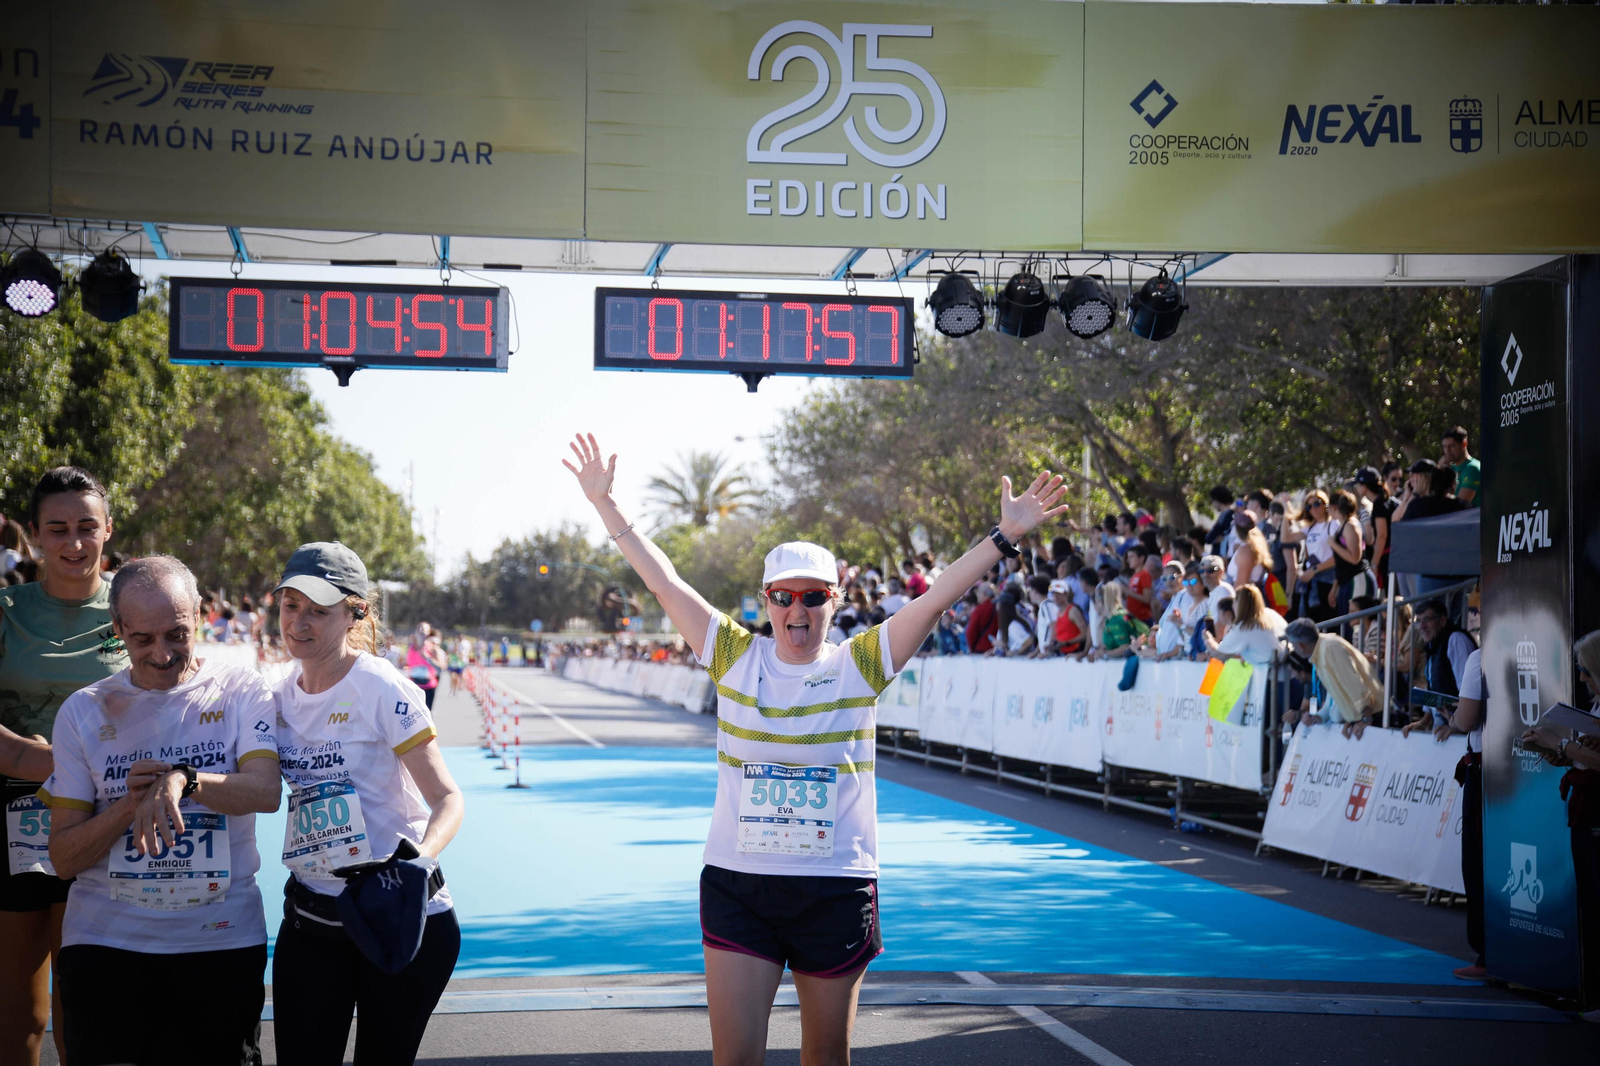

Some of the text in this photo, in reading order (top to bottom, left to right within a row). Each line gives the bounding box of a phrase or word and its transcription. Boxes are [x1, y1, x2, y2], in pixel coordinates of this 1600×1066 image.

[189, 61, 275, 82] RFEA
[180, 81, 266, 98] SERIES
[746, 19, 948, 168] 25
[173, 97, 315, 115] RUTA RUNNING
[79, 119, 494, 165] RAMÓN RUIZ ANDÚJAR
[1129, 133, 1249, 151] COOPERACIÓN
[1514, 131, 1588, 148] CIUDAD
[1129, 151, 1169, 165] 2005
[1227, 152, 1252, 160] cultura
[1290, 145, 1318, 156] 2020
[746, 173, 948, 220] EDICIÓN
[1500, 379, 1555, 410] COOPERACIÓN
[1500, 408, 1520, 428] 2005
[105, 739, 226, 766] Medio Maratón
[277, 740, 342, 756] edio Maratón
[310, 752, 345, 770] 2024
[1304, 756, 1351, 789] ALMERÍA
[104, 785, 130, 796] RAM
[750, 779, 828, 809] 5033
[1383, 770, 1446, 807] ALMERÍA
[777, 806, 794, 814] EVA
[1376, 804, 1409, 826] CIUDAD
[306, 833, 317, 842] DEL
[317, 825, 352, 839] CARMEN
[148, 860, 192, 868] ENRIQUE
